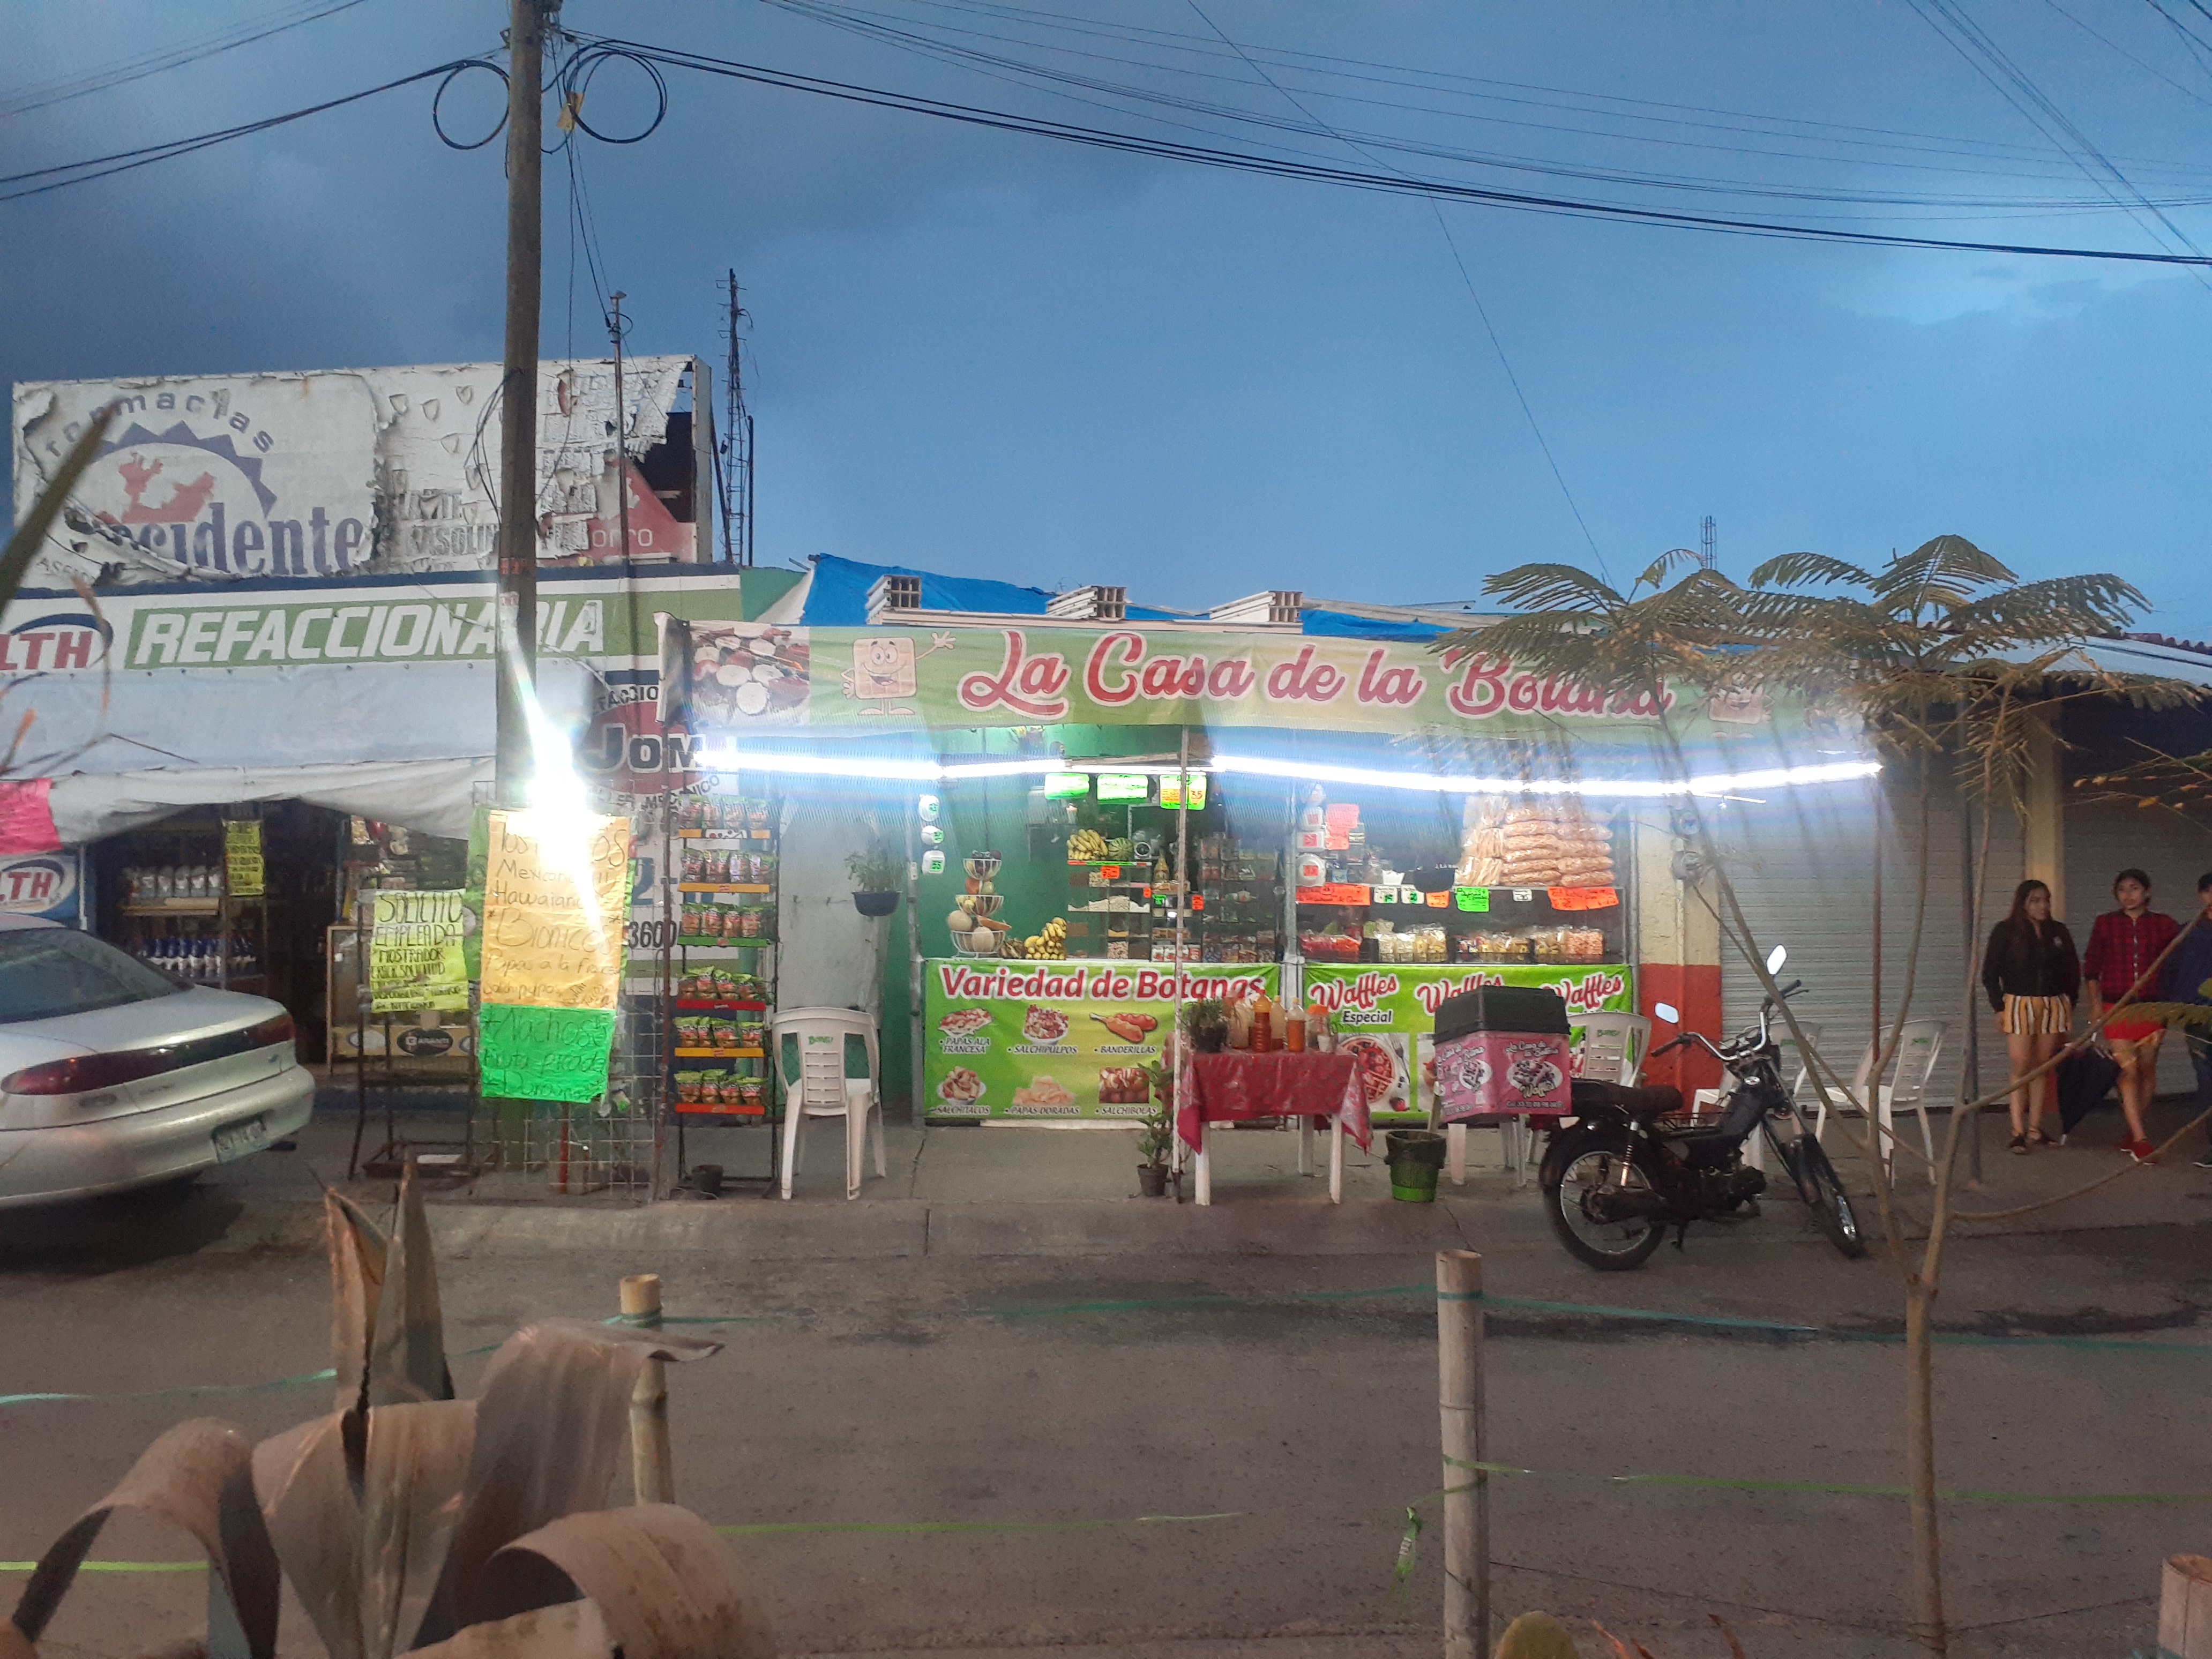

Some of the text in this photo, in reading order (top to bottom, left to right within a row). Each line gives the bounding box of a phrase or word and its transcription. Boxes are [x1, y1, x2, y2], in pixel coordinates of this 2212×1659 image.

[961, 630, 1068, 716] La
[1087, 632, 1254, 701] Casa
[1268, 644, 1346, 701] de
[1358, 648, 1423, 705] la
[0, 872, 54, 901] TH
[941, 967, 1085, 997] Variedad
[1092, 969, 1129, 998] de
[1310, 973, 1397, 1010] Waffles
[1343, 1010, 1393, 1025] Especial
